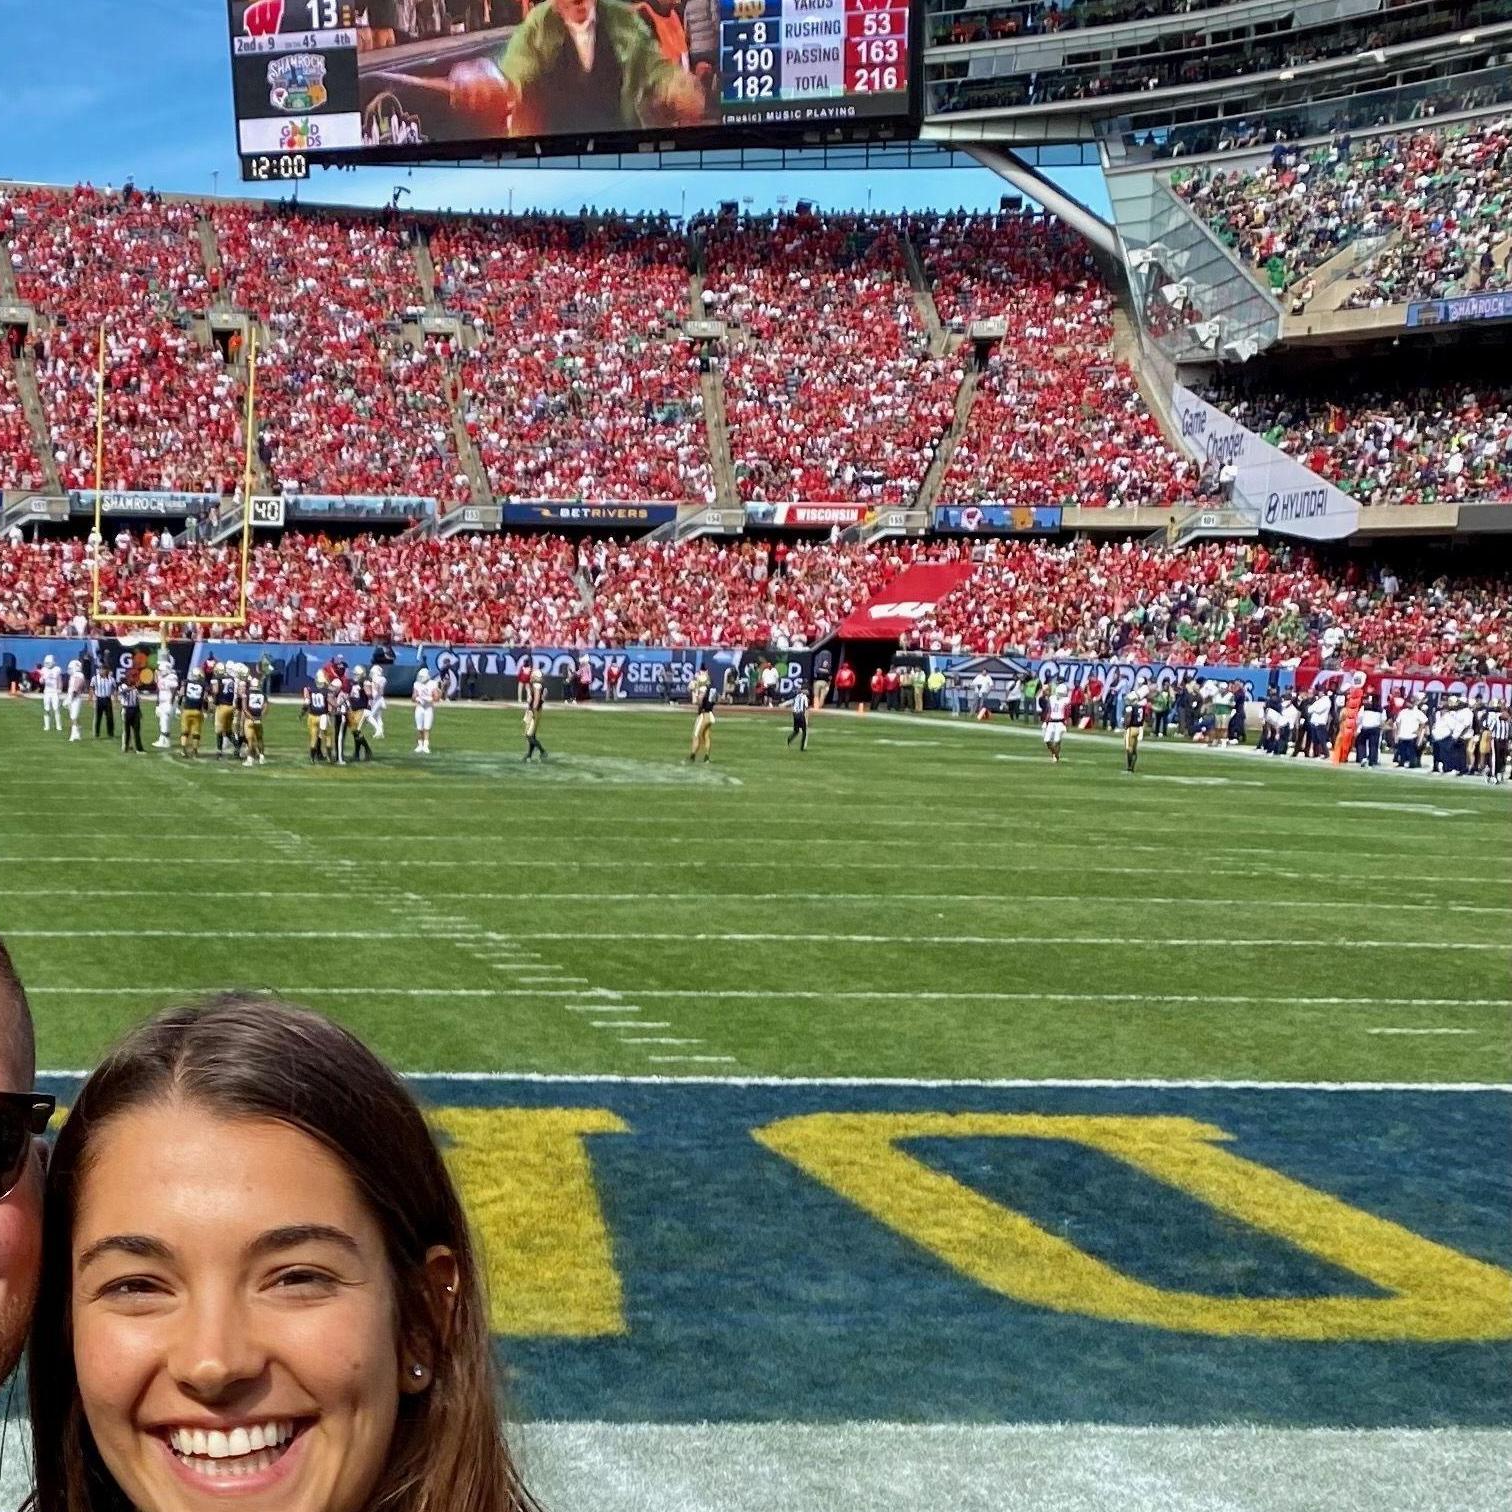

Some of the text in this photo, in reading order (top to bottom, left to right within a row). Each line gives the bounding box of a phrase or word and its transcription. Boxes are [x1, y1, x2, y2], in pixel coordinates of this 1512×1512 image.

[305, 0, 338, 29] 13
[785, 19, 841, 38] RUSHING
[863, 13, 891, 36] 53
[237, 36, 256, 52] 2nd
[267, 37, 275, 50] 9
[302, 34, 317, 48] 45
[334, 33, 351, 45] 4th
[268, 53, 326, 82] SHAMROCK
[732, 39, 899, 72] 190 PASSING 163
[732, 67, 897, 98] 182 TOTAL 216
[722, 106, 856, 124] (music) MUSIC PLAYING
[251, 154, 306, 179] 12:00
[1182, 408, 1207, 437] Game
[101, 494, 166, 514] SHAMROCK
[254, 500, 280, 521] 40
[559, 507, 649, 519] BETRIVERS
[796, 508, 859, 522] WISCONSIN
[1281, 488, 1329, 521] HYUNDAI
[627, 662, 694, 683] SERES
